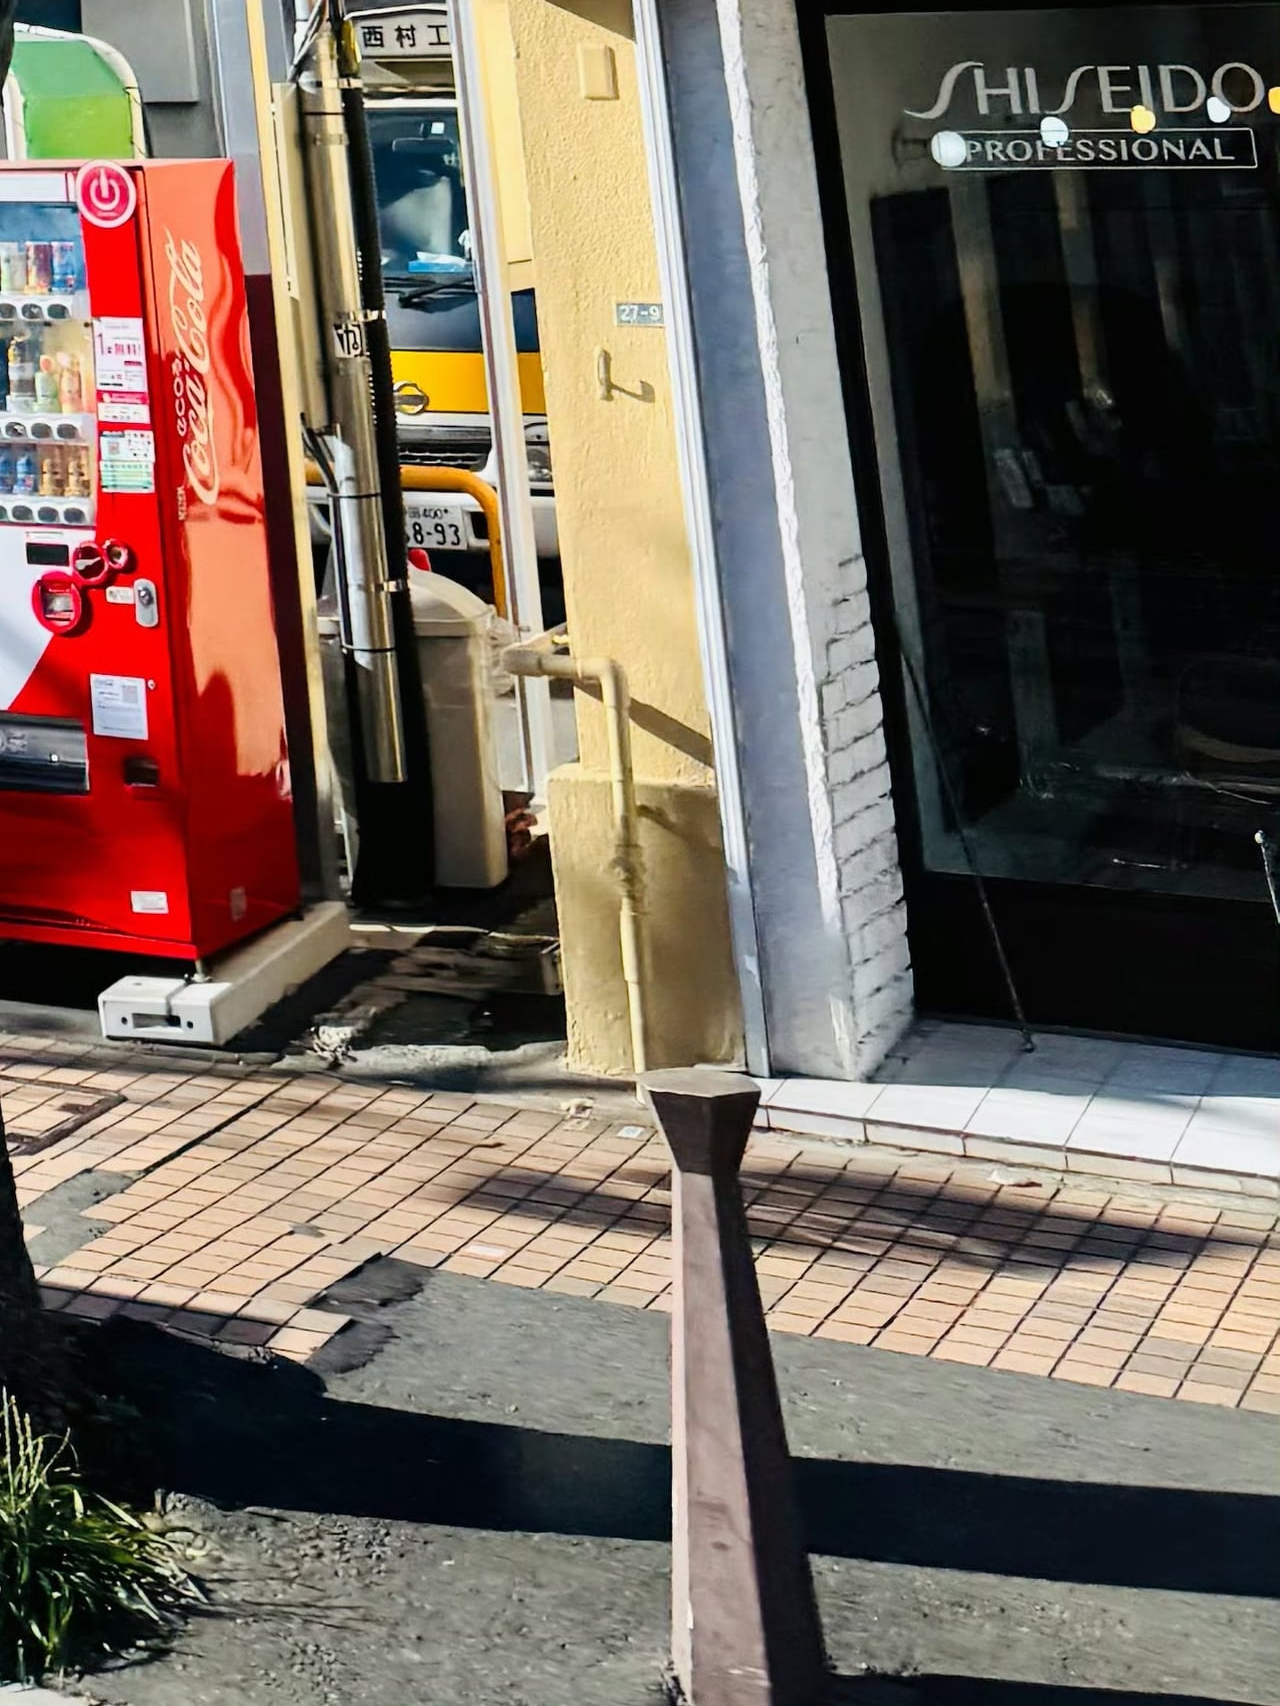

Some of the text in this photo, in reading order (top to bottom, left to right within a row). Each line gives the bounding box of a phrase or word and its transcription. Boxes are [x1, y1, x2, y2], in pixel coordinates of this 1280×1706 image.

[903, 61, 1265, 120] SHISEIDO
[619, 305, 661, 324] 27-9
[164, 227, 219, 505] Coca-Cola
[408, 521, 461, 546] 8-93
